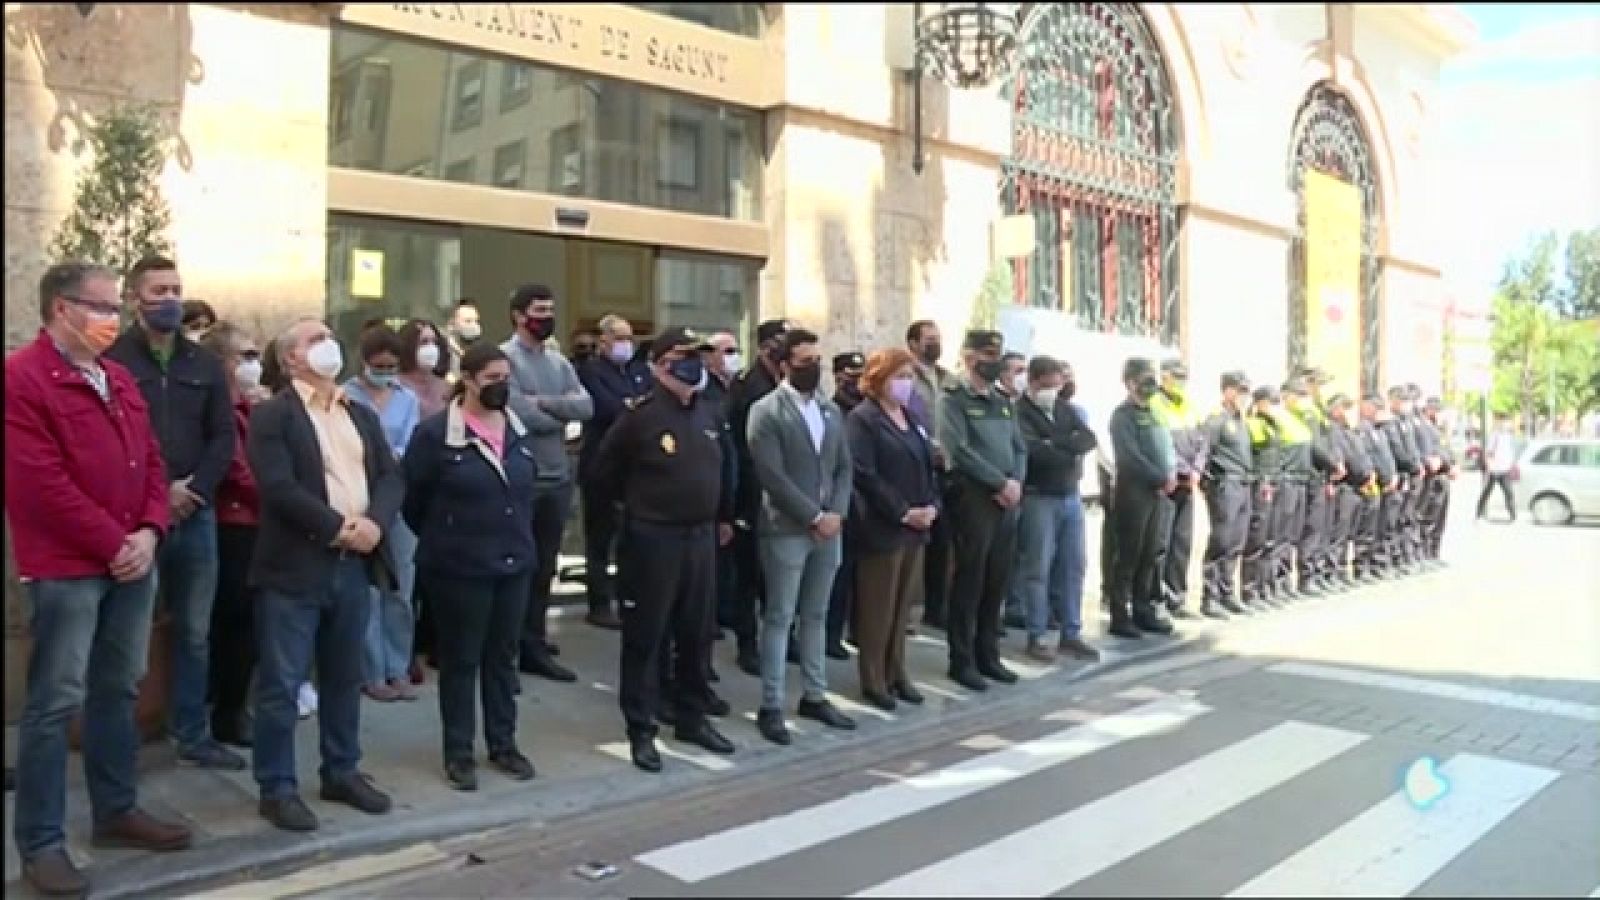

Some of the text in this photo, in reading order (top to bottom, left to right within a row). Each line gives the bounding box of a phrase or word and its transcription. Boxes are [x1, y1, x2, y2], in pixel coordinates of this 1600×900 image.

[391, 4, 729, 83] UNTAMENT DE SAGUNT
